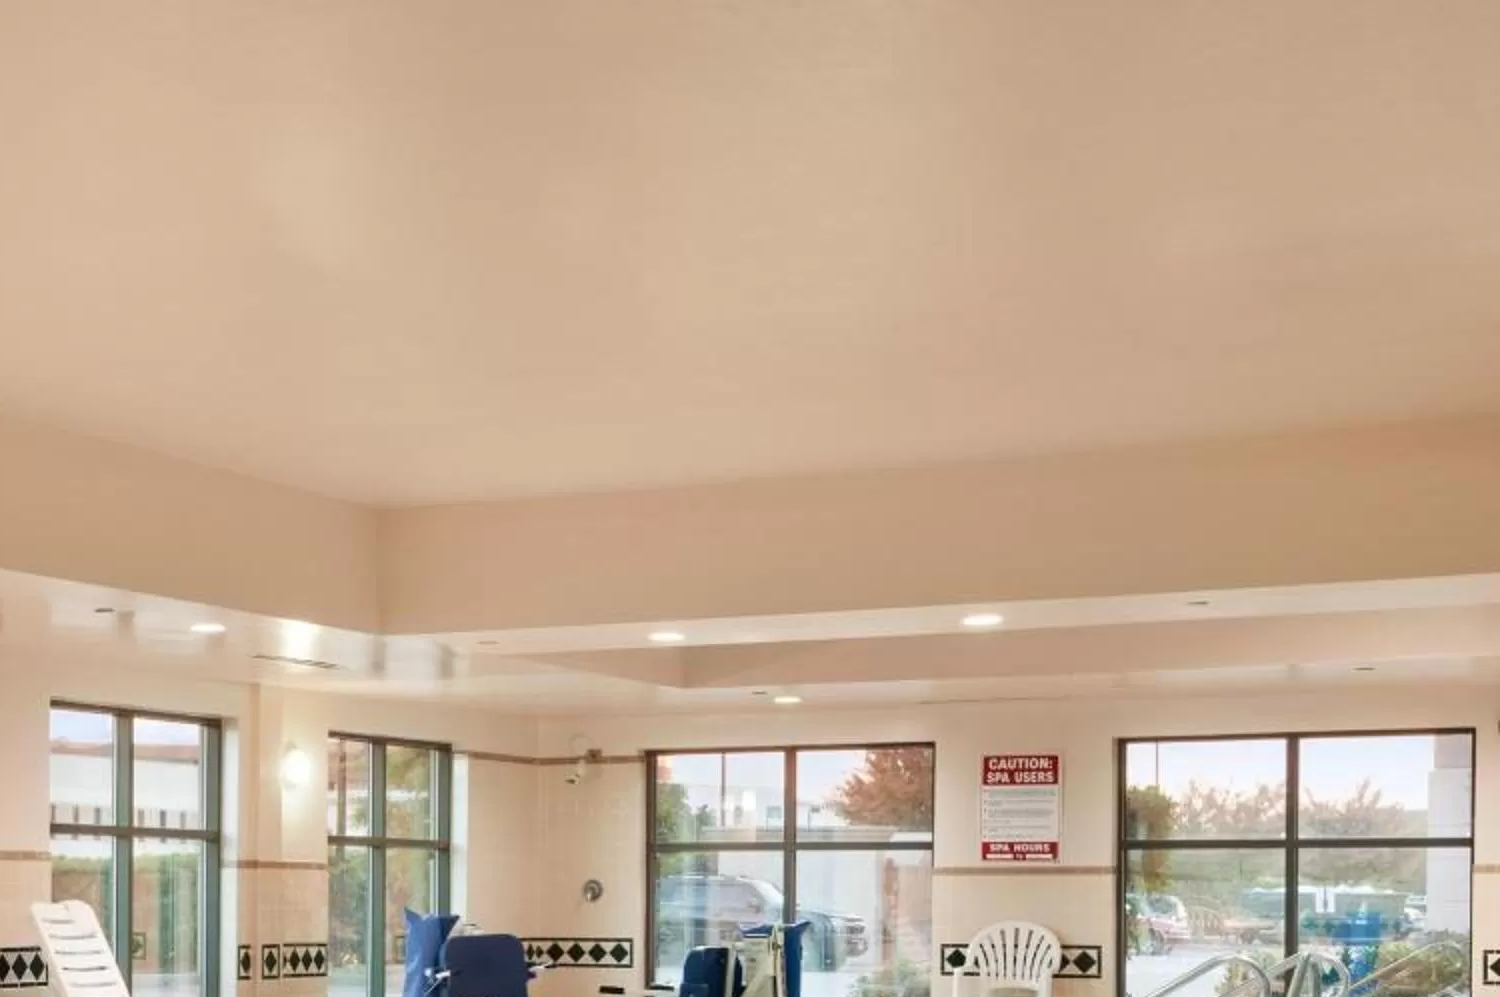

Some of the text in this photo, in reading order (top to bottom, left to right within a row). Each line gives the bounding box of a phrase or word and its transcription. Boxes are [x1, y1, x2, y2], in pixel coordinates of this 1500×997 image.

[989, 758, 1053, 770] CAUTION:
[986, 771, 1053, 783] SPA USERS
[989, 843, 1051, 853] SPA HOURS
